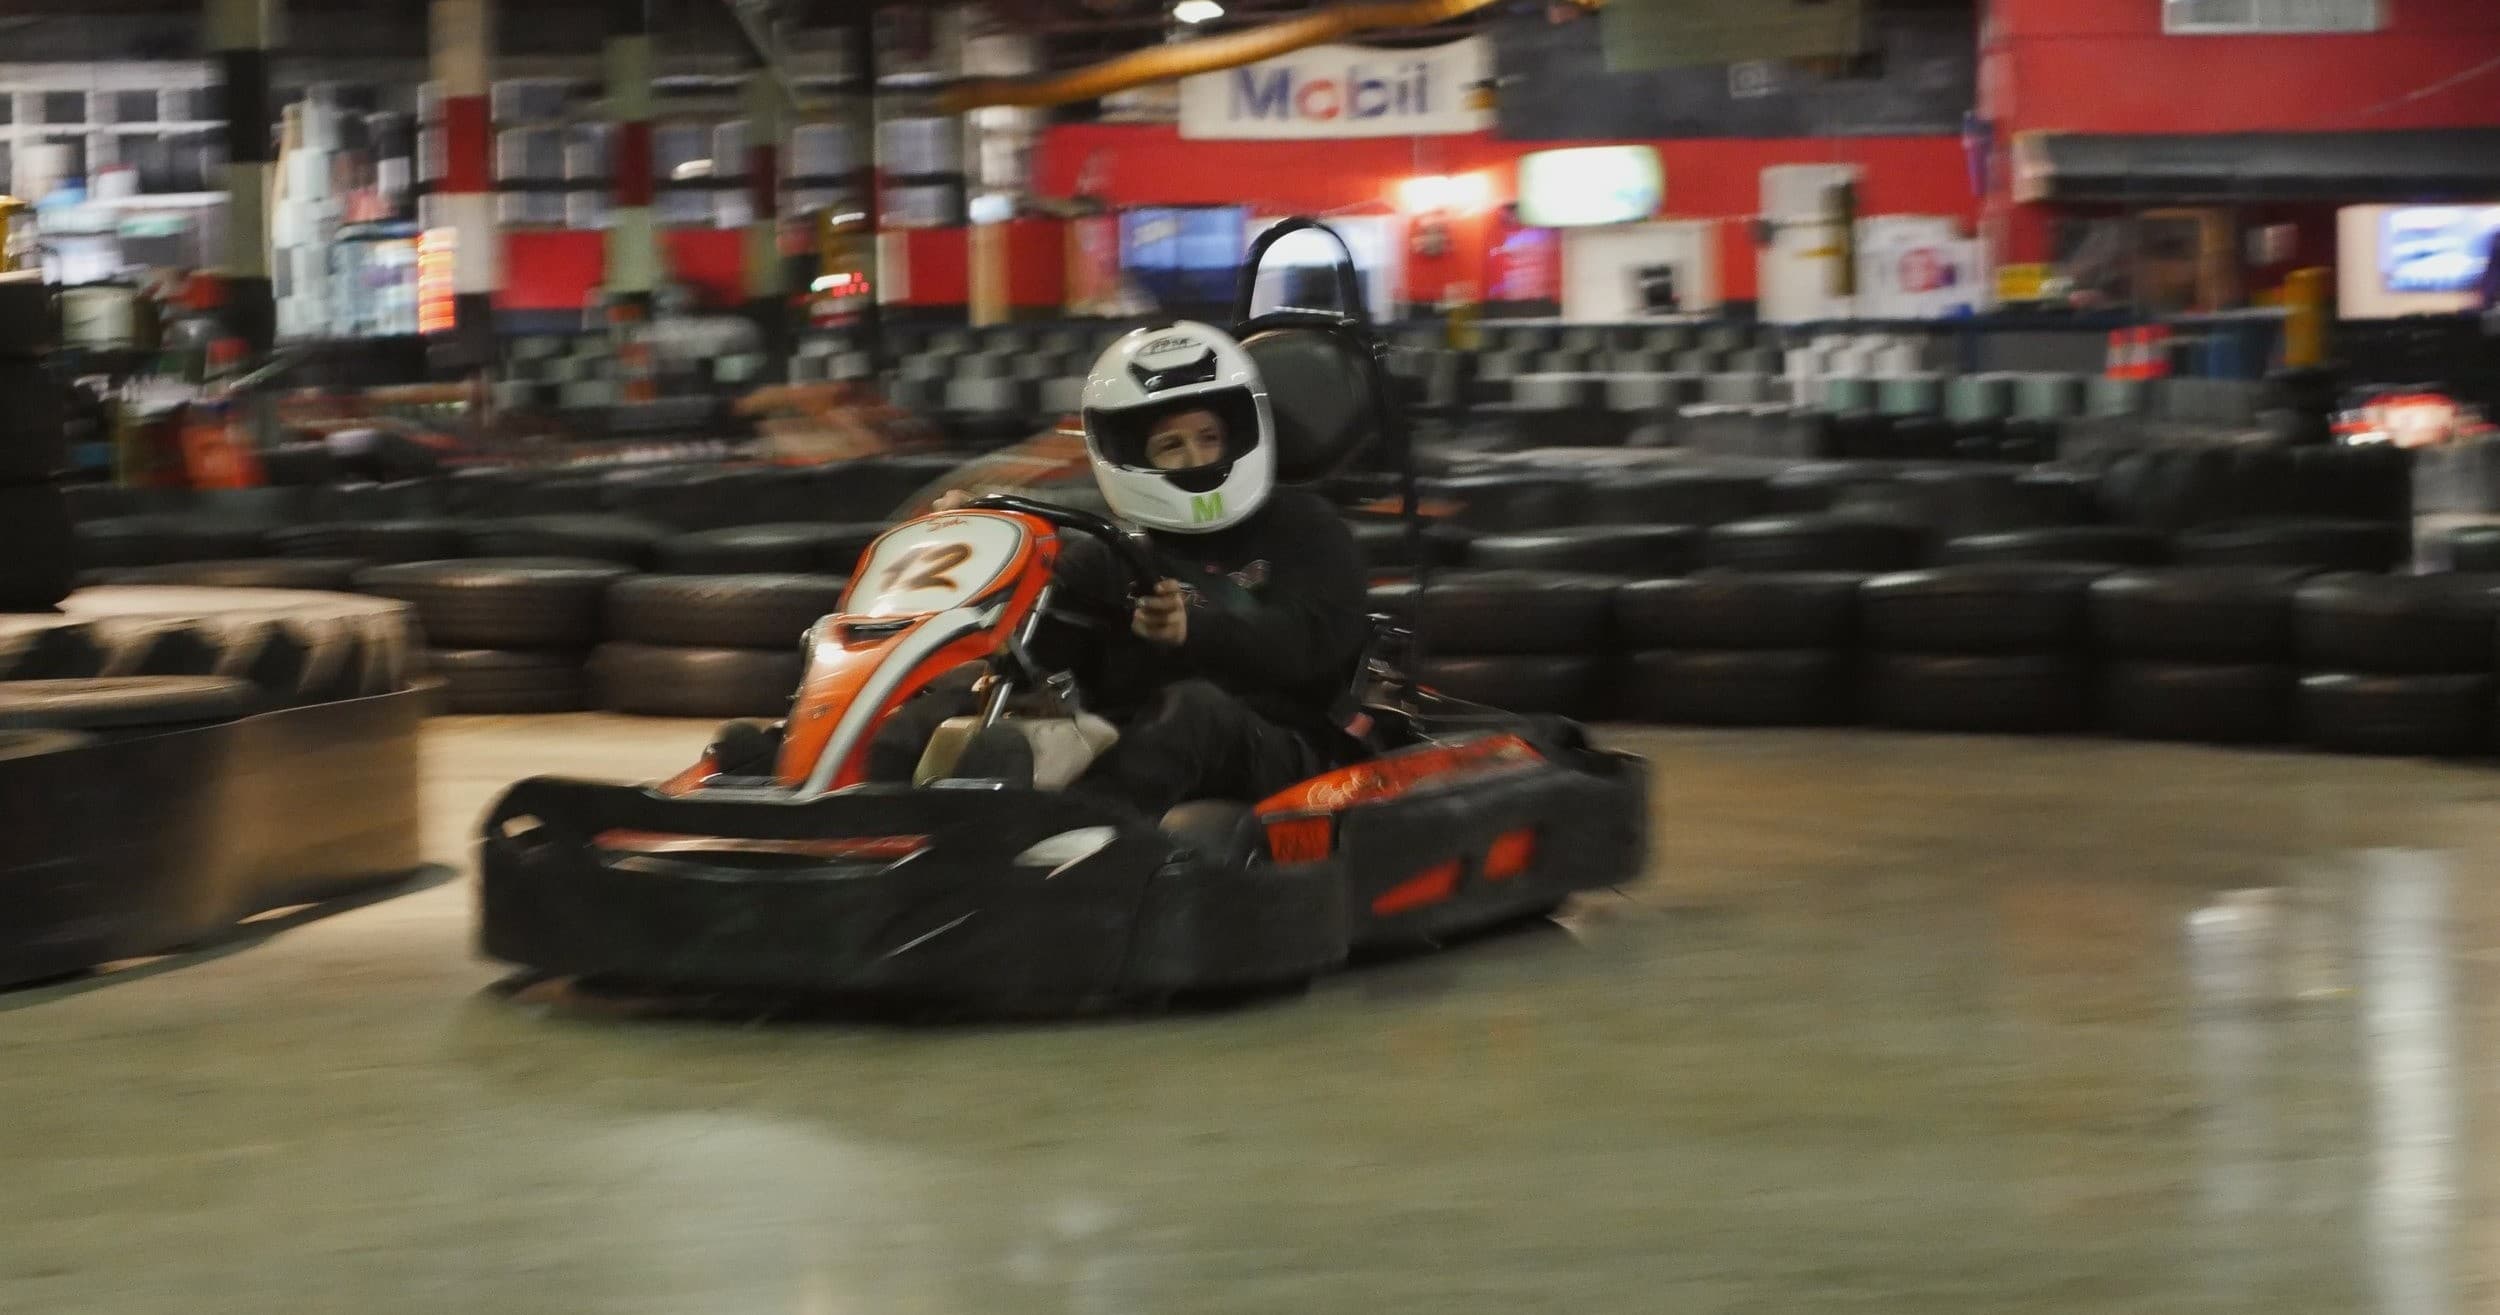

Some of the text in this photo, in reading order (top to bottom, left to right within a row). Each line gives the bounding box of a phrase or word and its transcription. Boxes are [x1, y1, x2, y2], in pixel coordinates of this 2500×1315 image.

[1227, 60, 1429, 121] Mobil
[1190, 491, 1225, 523] M
[880, 541, 973, 592] 12
